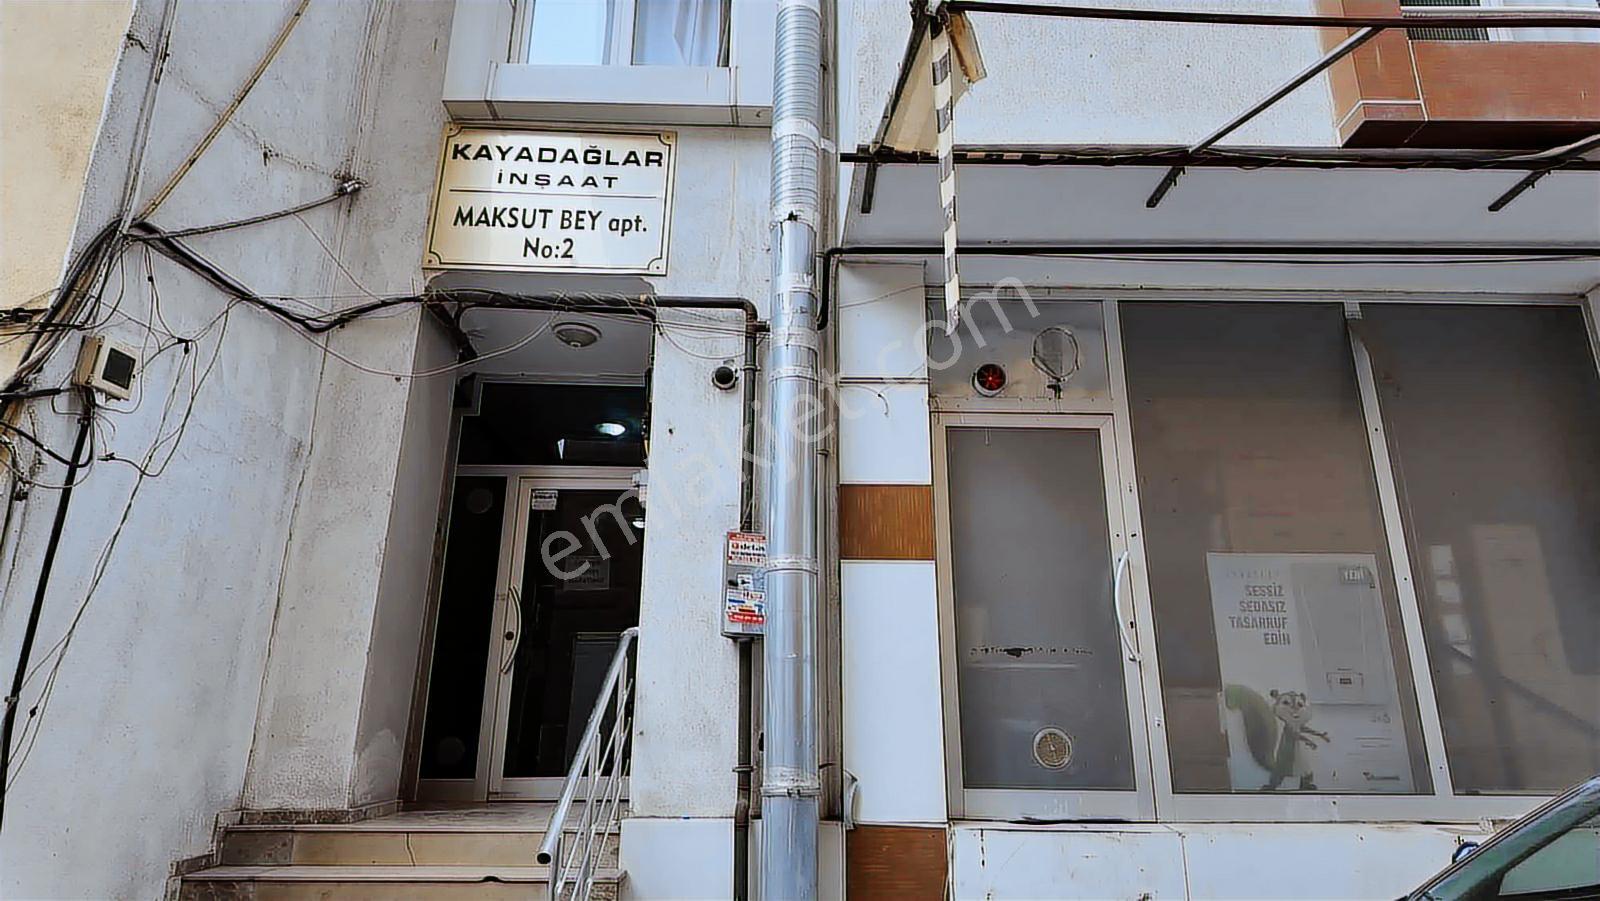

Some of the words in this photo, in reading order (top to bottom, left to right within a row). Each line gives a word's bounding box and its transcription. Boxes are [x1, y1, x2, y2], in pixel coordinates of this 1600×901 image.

[451, 144, 663, 167] KAYADAĞLAR
[497, 169, 618, 189] İNŞAAT
[453, 206, 552, 230] MAKSUT
[560, 210, 602, 231] BEY
[608, 215, 647, 236] apt.
[523, 237, 574, 259] No:2
[1245, 582, 1285, 597] SESSİZ
